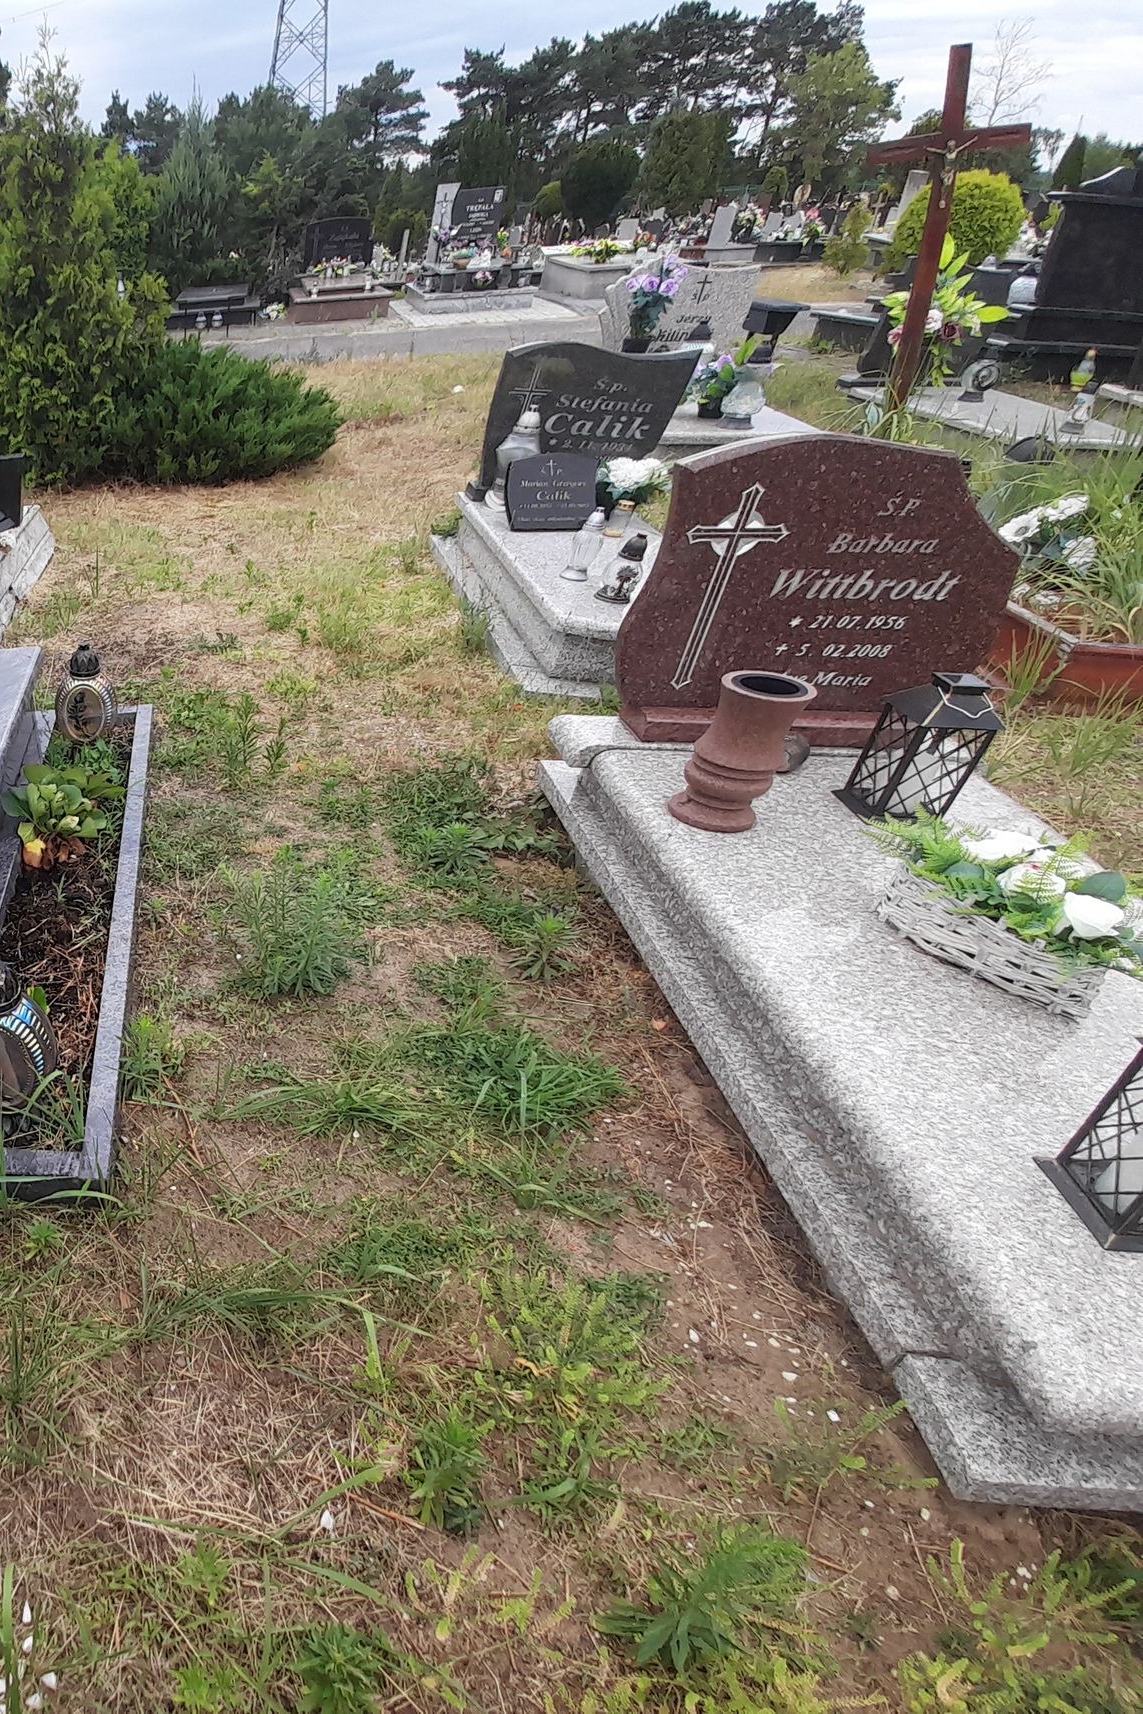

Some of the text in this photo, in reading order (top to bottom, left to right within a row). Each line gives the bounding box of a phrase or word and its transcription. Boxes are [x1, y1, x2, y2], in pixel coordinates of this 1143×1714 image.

[556, 394, 654, 413] Stefania
[544, 413, 650, 440] Calik
[537, 490, 571, 501] Calik
[826, 532, 940, 554] Barbara
[768, 568, 962, 601] Wittbrodt
[809, 615, 907, 629] 21.07.1956
[822, 643, 893, 657] 02.2008
[811, 671, 873, 686] Maria
